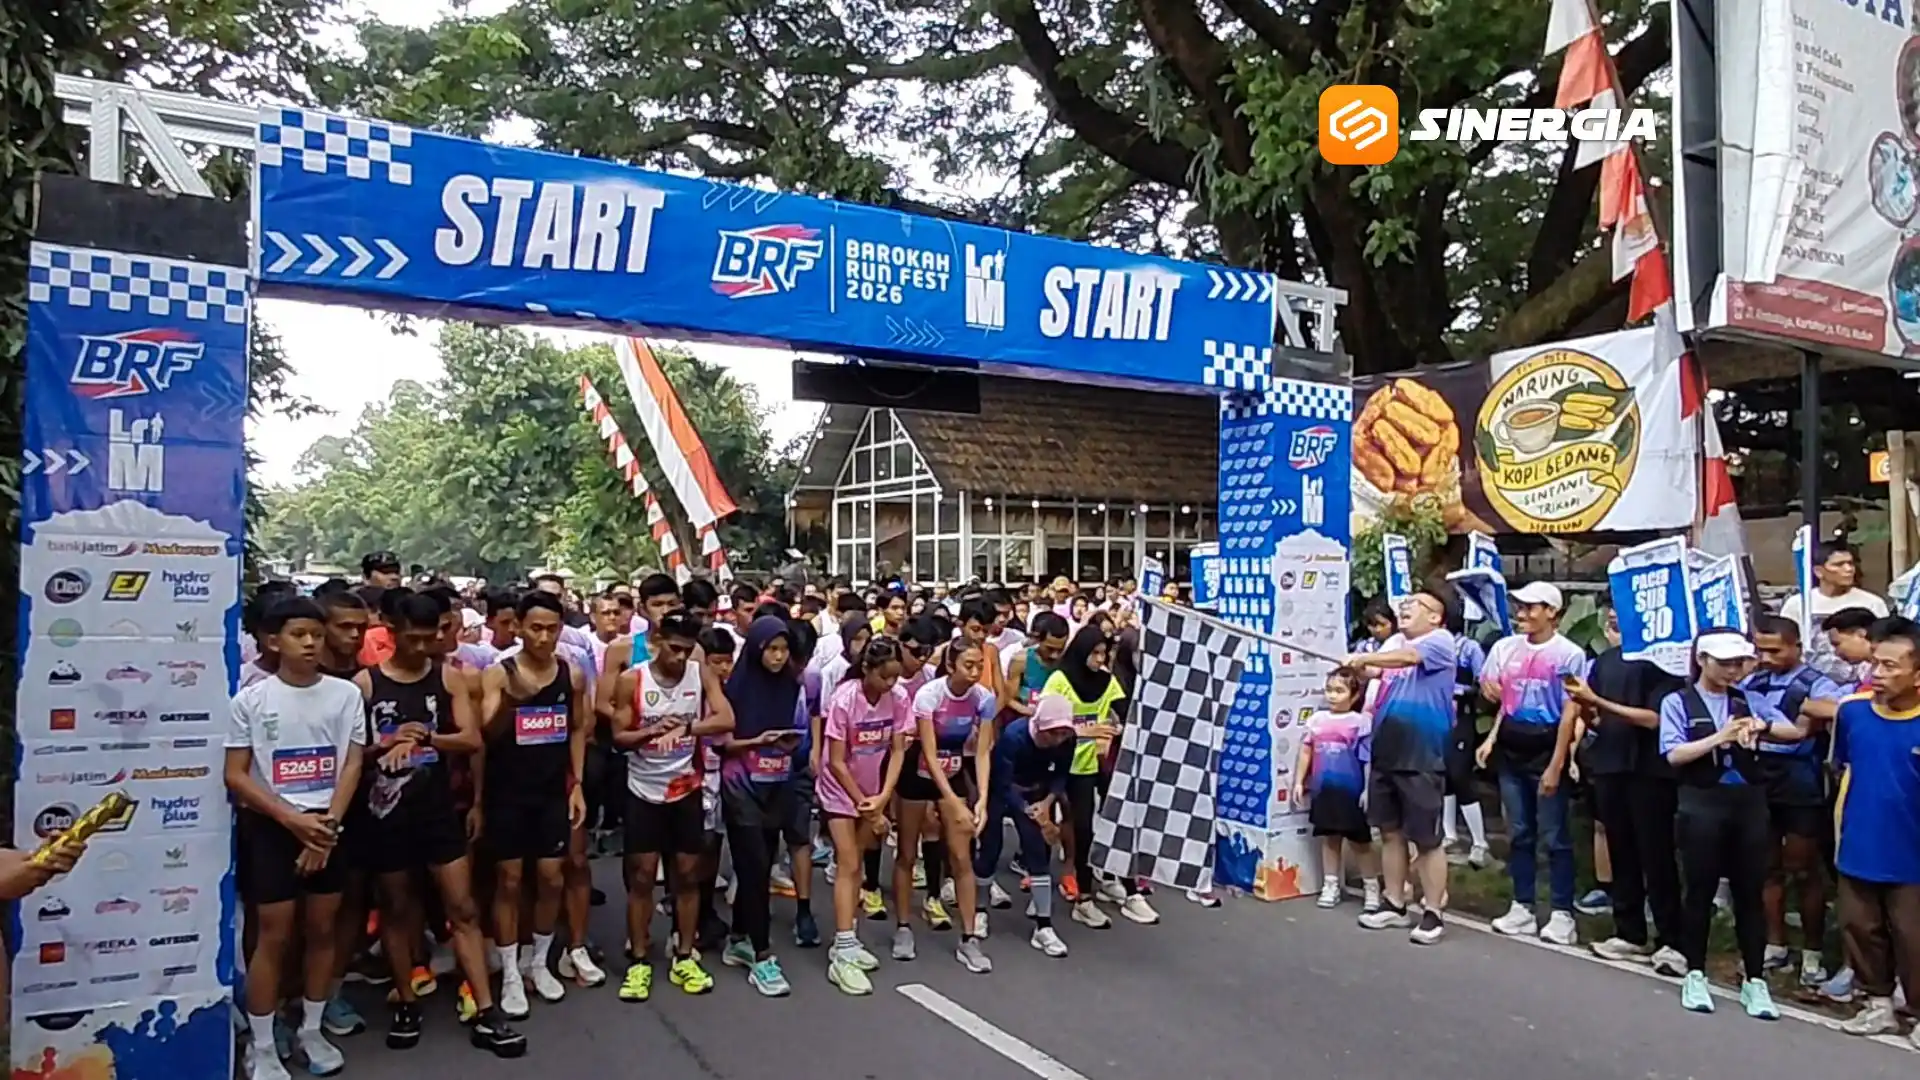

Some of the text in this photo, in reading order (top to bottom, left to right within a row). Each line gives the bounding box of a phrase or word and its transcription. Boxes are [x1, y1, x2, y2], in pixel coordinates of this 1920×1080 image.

[435, 174, 665, 273] START
[711, 228, 824, 292] BRF
[846, 239, 950, 273] BAROKAH
[846, 259, 950, 292] RUN FEST
[846, 279, 903, 304] 2026
[1040, 265, 1182, 341] START
[70, 330, 205, 394] BRF
[1502, 368, 1580, 408] WARUNG
[1288, 429, 1338, 467] BRF
[1504, 447, 1611, 485] KOPI GEDANG
[1523, 475, 1584, 506] SINTANI
[1537, 498, 1581, 516] TRIKOPI
[47, 540, 119, 553] bankjatim
[162, 569, 211, 584] hydro
[174, 583, 210, 597] plus
[1632, 567, 1670, 592] PACER
[1635, 586, 1668, 613] SUB
[1641, 606, 1673, 642] 30
[521, 716, 552, 730] 5669
[36, 771, 107, 785] bankjatim
[279, 759, 318, 776] 5265
[151, 795, 200, 811] hydro
[162, 810, 199, 825] plus
